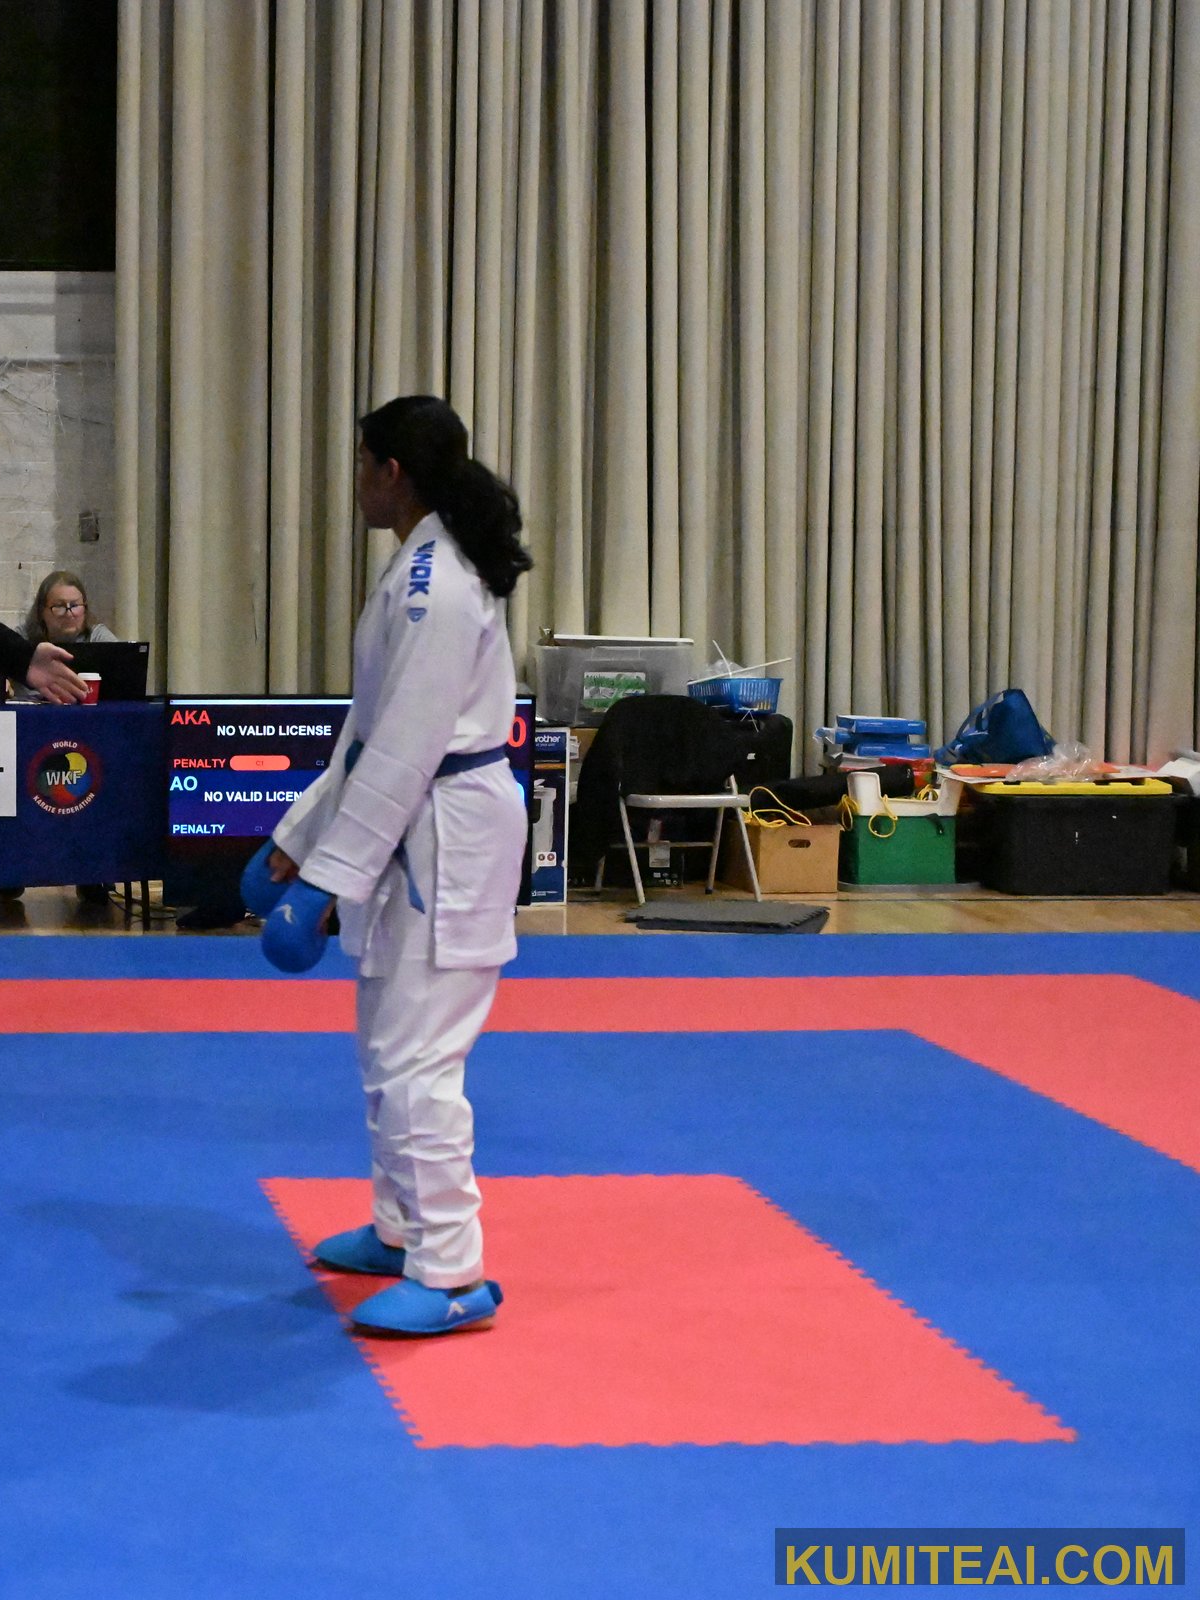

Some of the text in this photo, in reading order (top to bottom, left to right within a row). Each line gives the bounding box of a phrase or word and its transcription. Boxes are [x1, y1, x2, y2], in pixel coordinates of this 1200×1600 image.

[171, 710, 211, 725] AKA
[216, 725, 332, 736] NO VALID LICENSE
[508, 716, 527, 747] 0
[52, 740, 78, 749] WORLD
[535, 735, 561, 743] rother
[173, 758, 226, 768] PENALTY
[46, 770, 81, 786] WKF
[169, 776, 198, 791] AO
[204, 791, 302, 802] NO VALID LICEN
[33, 792, 95, 815] KARATE FEDERATION
[172, 824, 225, 834] PENALTY
